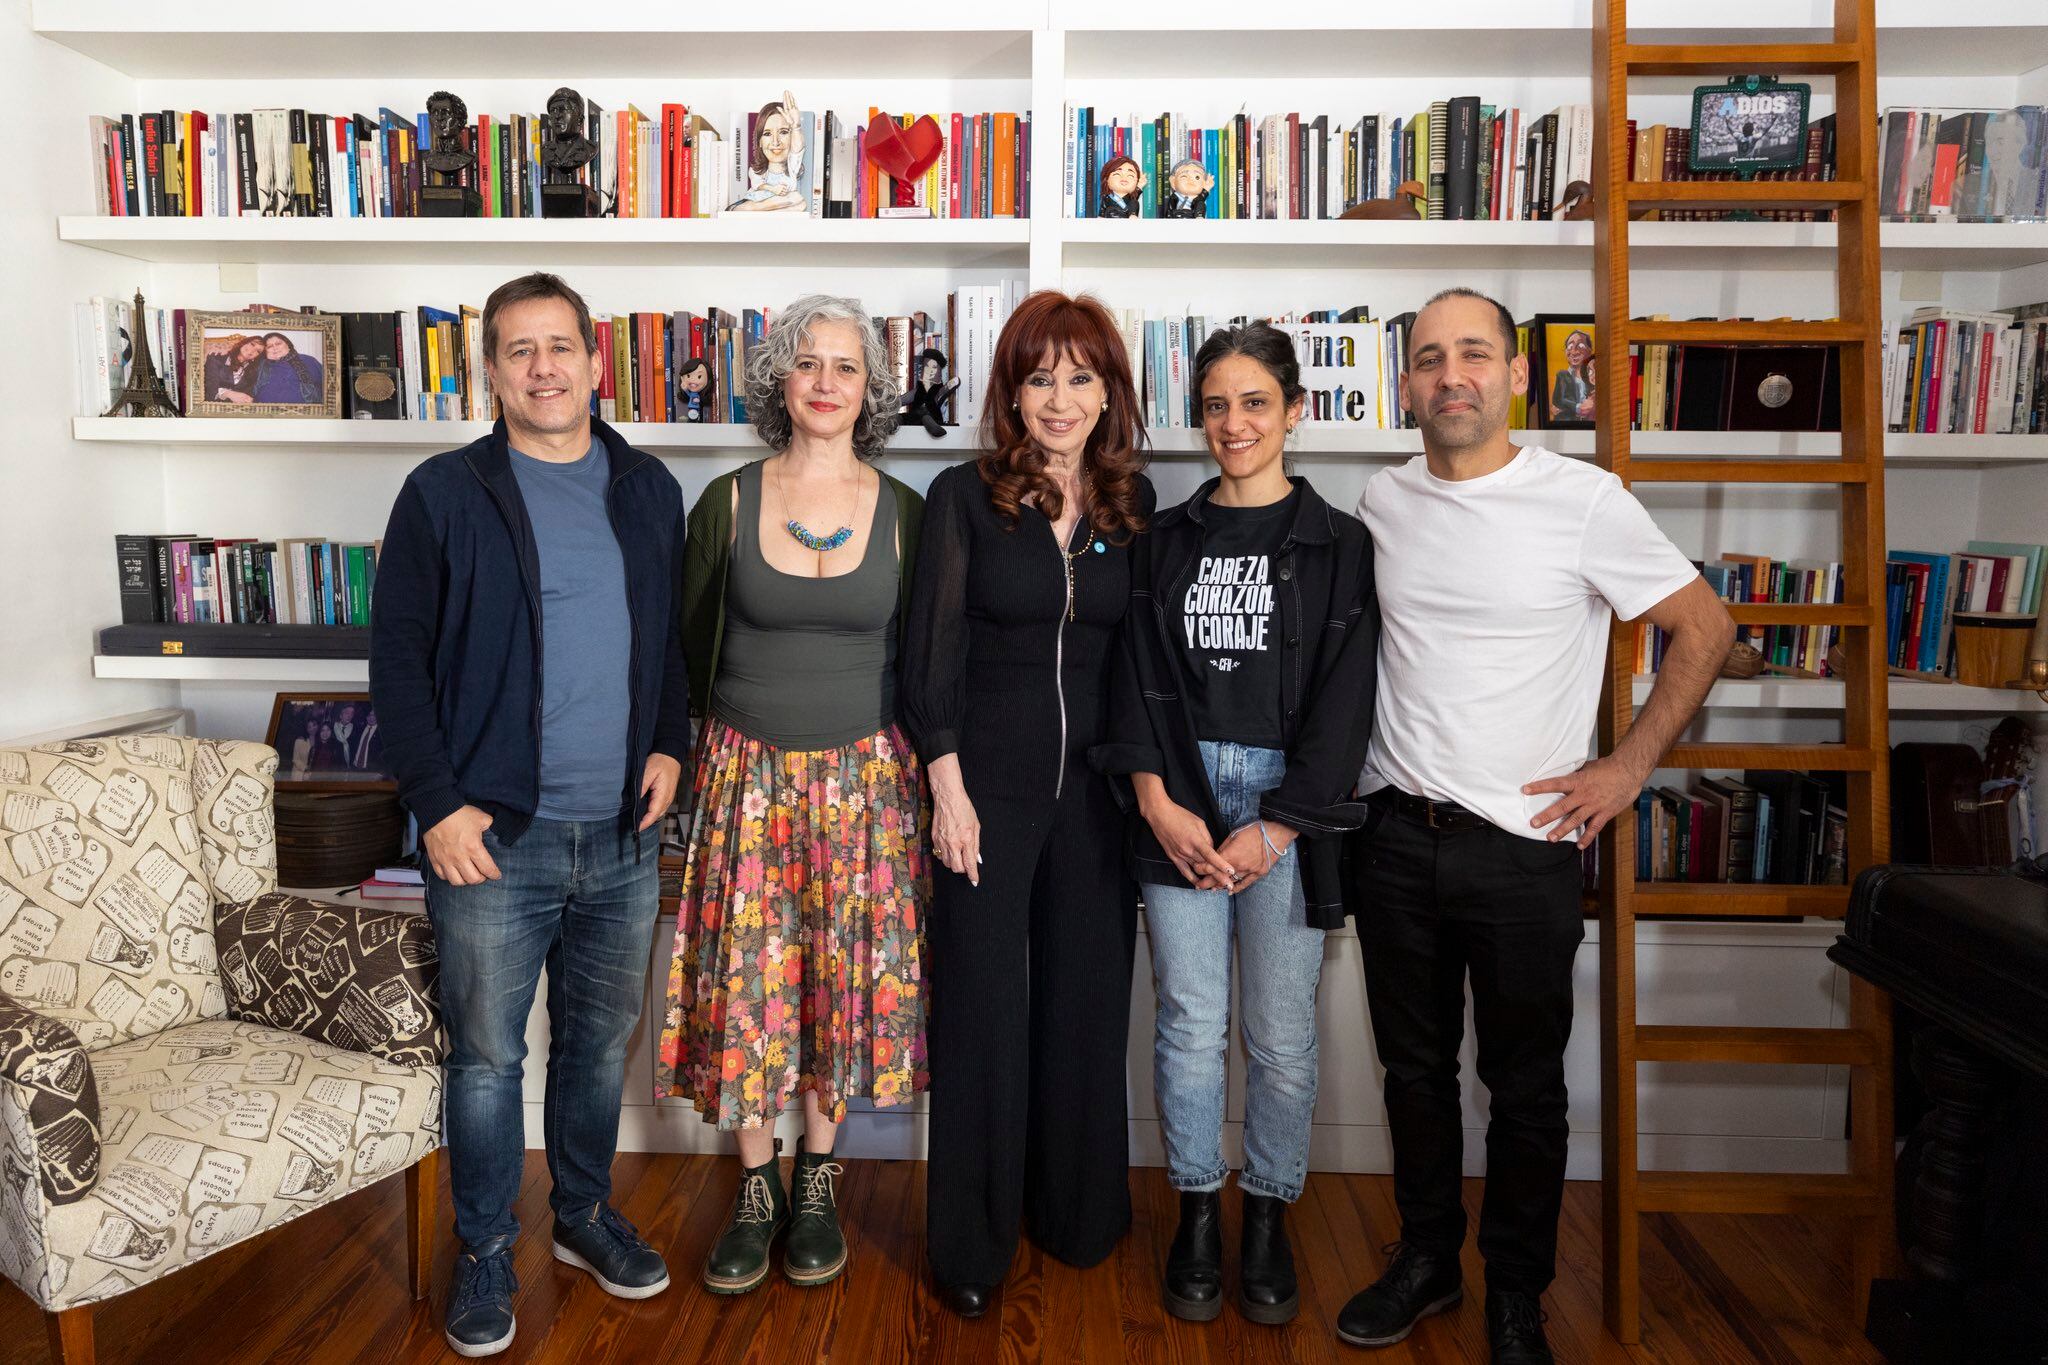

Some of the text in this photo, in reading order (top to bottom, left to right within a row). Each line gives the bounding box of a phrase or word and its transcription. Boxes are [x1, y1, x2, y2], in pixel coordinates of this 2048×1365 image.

[1717, 95, 1788, 116] ADIOS
[145, 118, 159, 173] Indio Solari
[1545, 143, 1553, 168] imperio
[243, 181, 252, 205] Comentarios
[1543, 179, 1551, 201] cloacas
[2036, 169, 2047, 209] Argentina
[1297, 330, 1356, 368] ina
[1171, 350, 1179, 384] GALIMBERTI
[158, 546, 168, 587] CUMBRES
[181, 549, 189, 567] Madre
[1197, 555, 1269, 585] CABEZA
[1184, 582, 1273, 614] CORAZÓN
[1183, 615, 1270, 651] Y CORAJE
[110, 787, 137, 806] Chocolat
[117, 784, 135, 797] Cafes
[223, 797, 248, 812] hocolat
[65, 866, 82, 879] Pates
[64, 877, 85, 893] Sirops
[22, 915, 43, 930] Sirops
[10, 933, 40, 952] Chocolat
[24, 929, 42, 942] Pates
[181, 933, 192, 958] 173474
[15, 964, 29, 992] 173474
[363, 1112, 388, 1126] Chocolat
[374, 1105, 392, 1115] Pates
[238, 1121, 263, 1129] Sirops
[207, 1159, 229, 1171] Sirops
[363, 1141, 379, 1170] 173474
[199, 1179, 231, 1198] Chocolat
[213, 1174, 233, 1186] Pates
[200, 1211, 219, 1241] 173474
